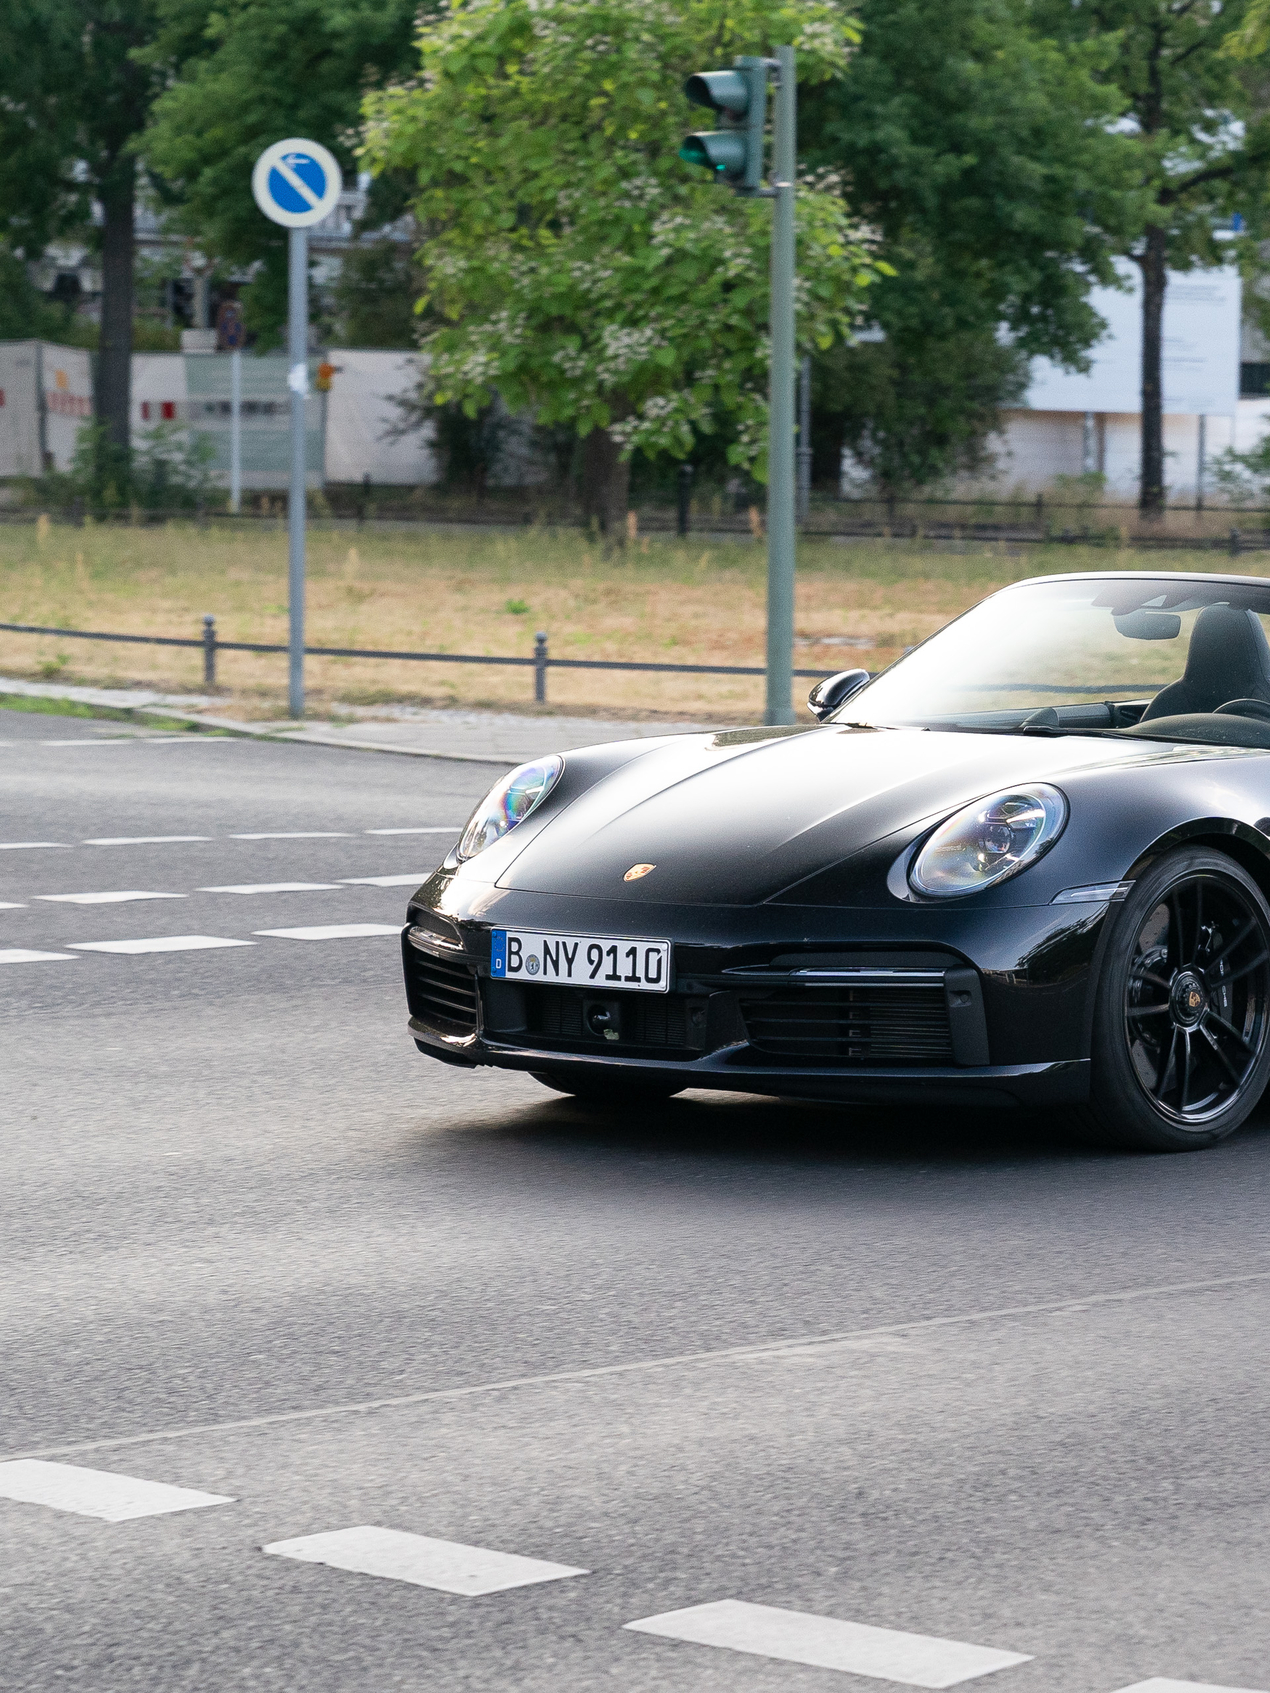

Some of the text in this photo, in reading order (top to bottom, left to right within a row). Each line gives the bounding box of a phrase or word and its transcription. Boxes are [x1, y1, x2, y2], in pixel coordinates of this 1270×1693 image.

[495, 958, 502, 969] D
[507, 936, 663, 984] B NY 9110
